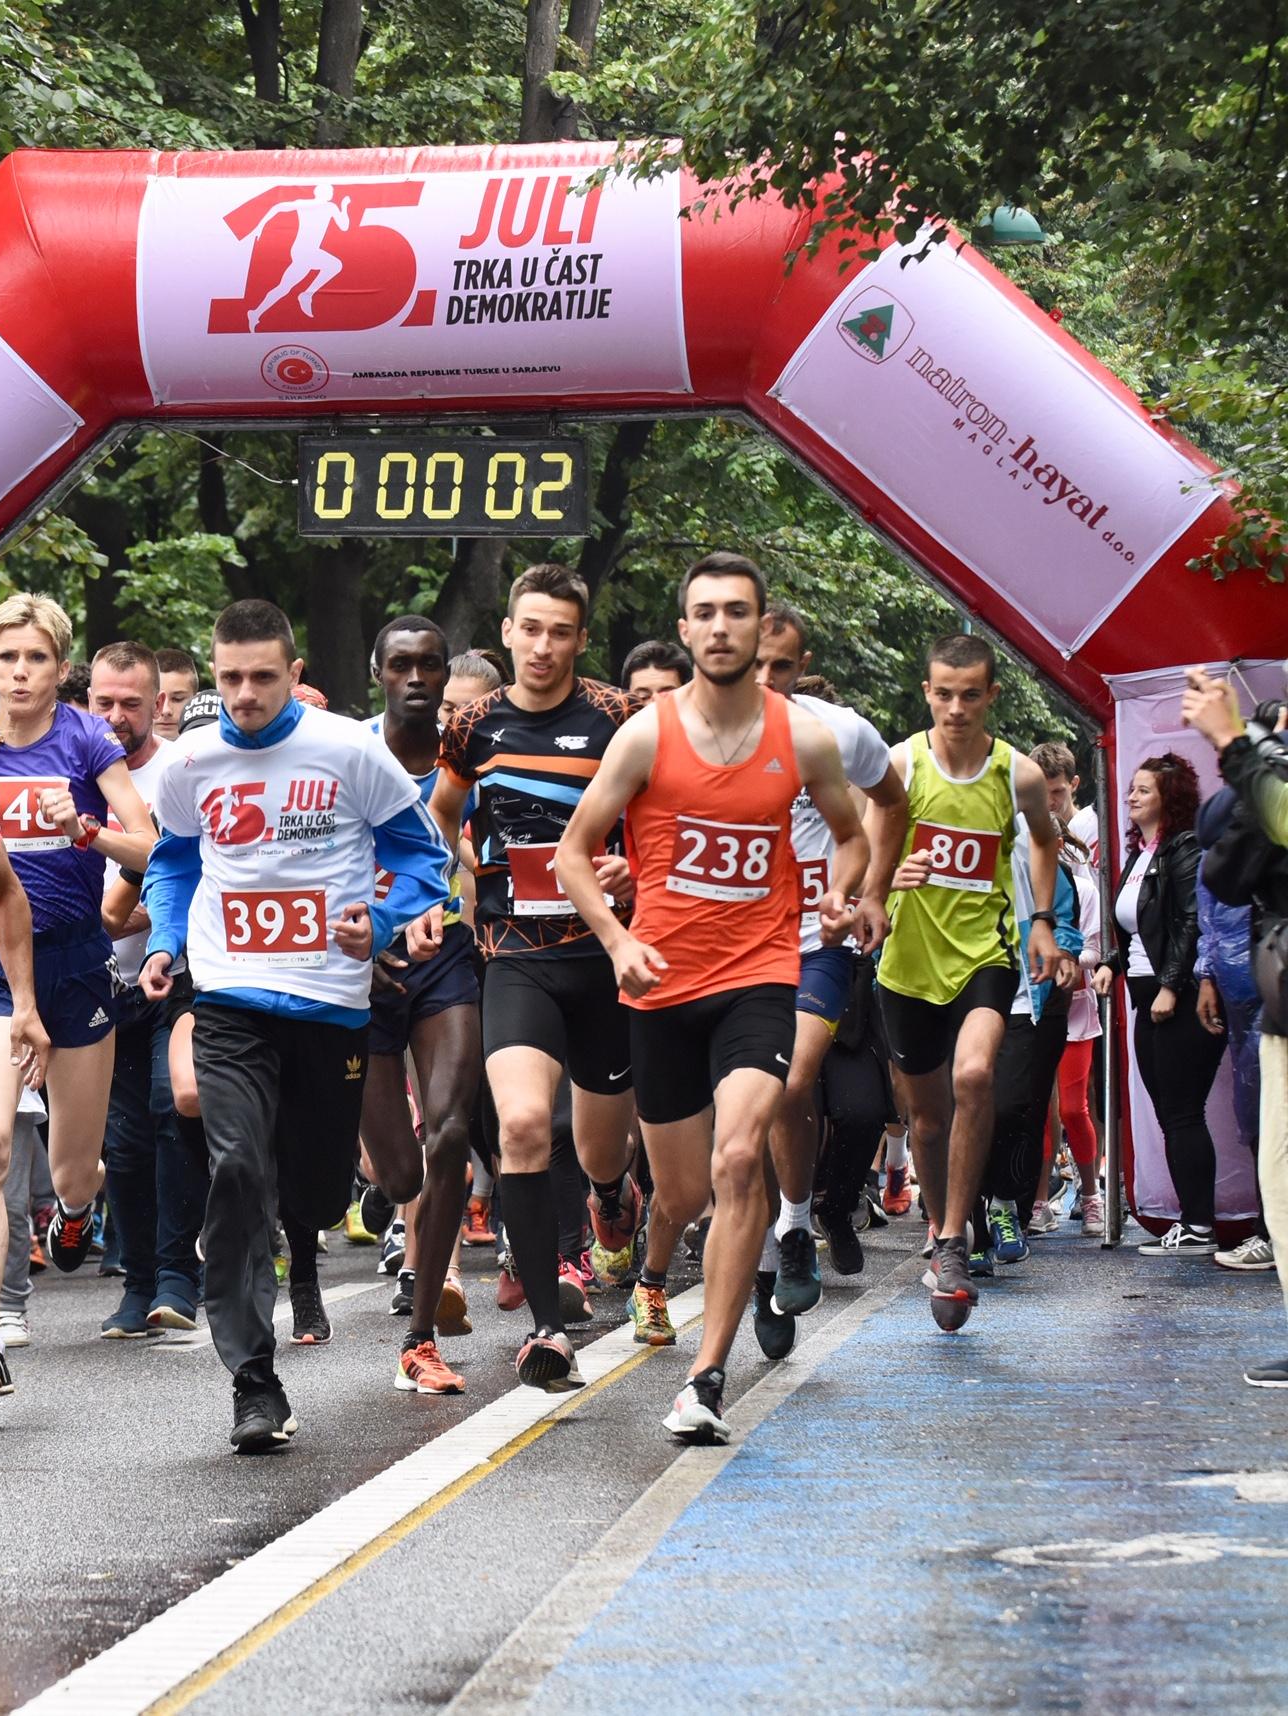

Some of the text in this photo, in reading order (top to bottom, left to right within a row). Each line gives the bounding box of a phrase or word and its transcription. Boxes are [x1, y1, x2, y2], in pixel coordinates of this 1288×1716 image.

[458, 175, 603, 250] JULI
[453, 247, 603, 290] TRKA U ČAST
[445, 288, 612, 325] DEMOKRATIJE
[352, 365, 561, 379] AMBASADA REPUBLIKE TURSKE U SARAJEVU
[952, 417, 1033, 491] MAGLAJ
[281, 780, 339, 812] JULI
[279, 811, 336, 828] TRKA U ČAST
[675, 829, 771, 881] 238
[931, 834, 981, 874] 80
[227, 898, 319, 946] 393
